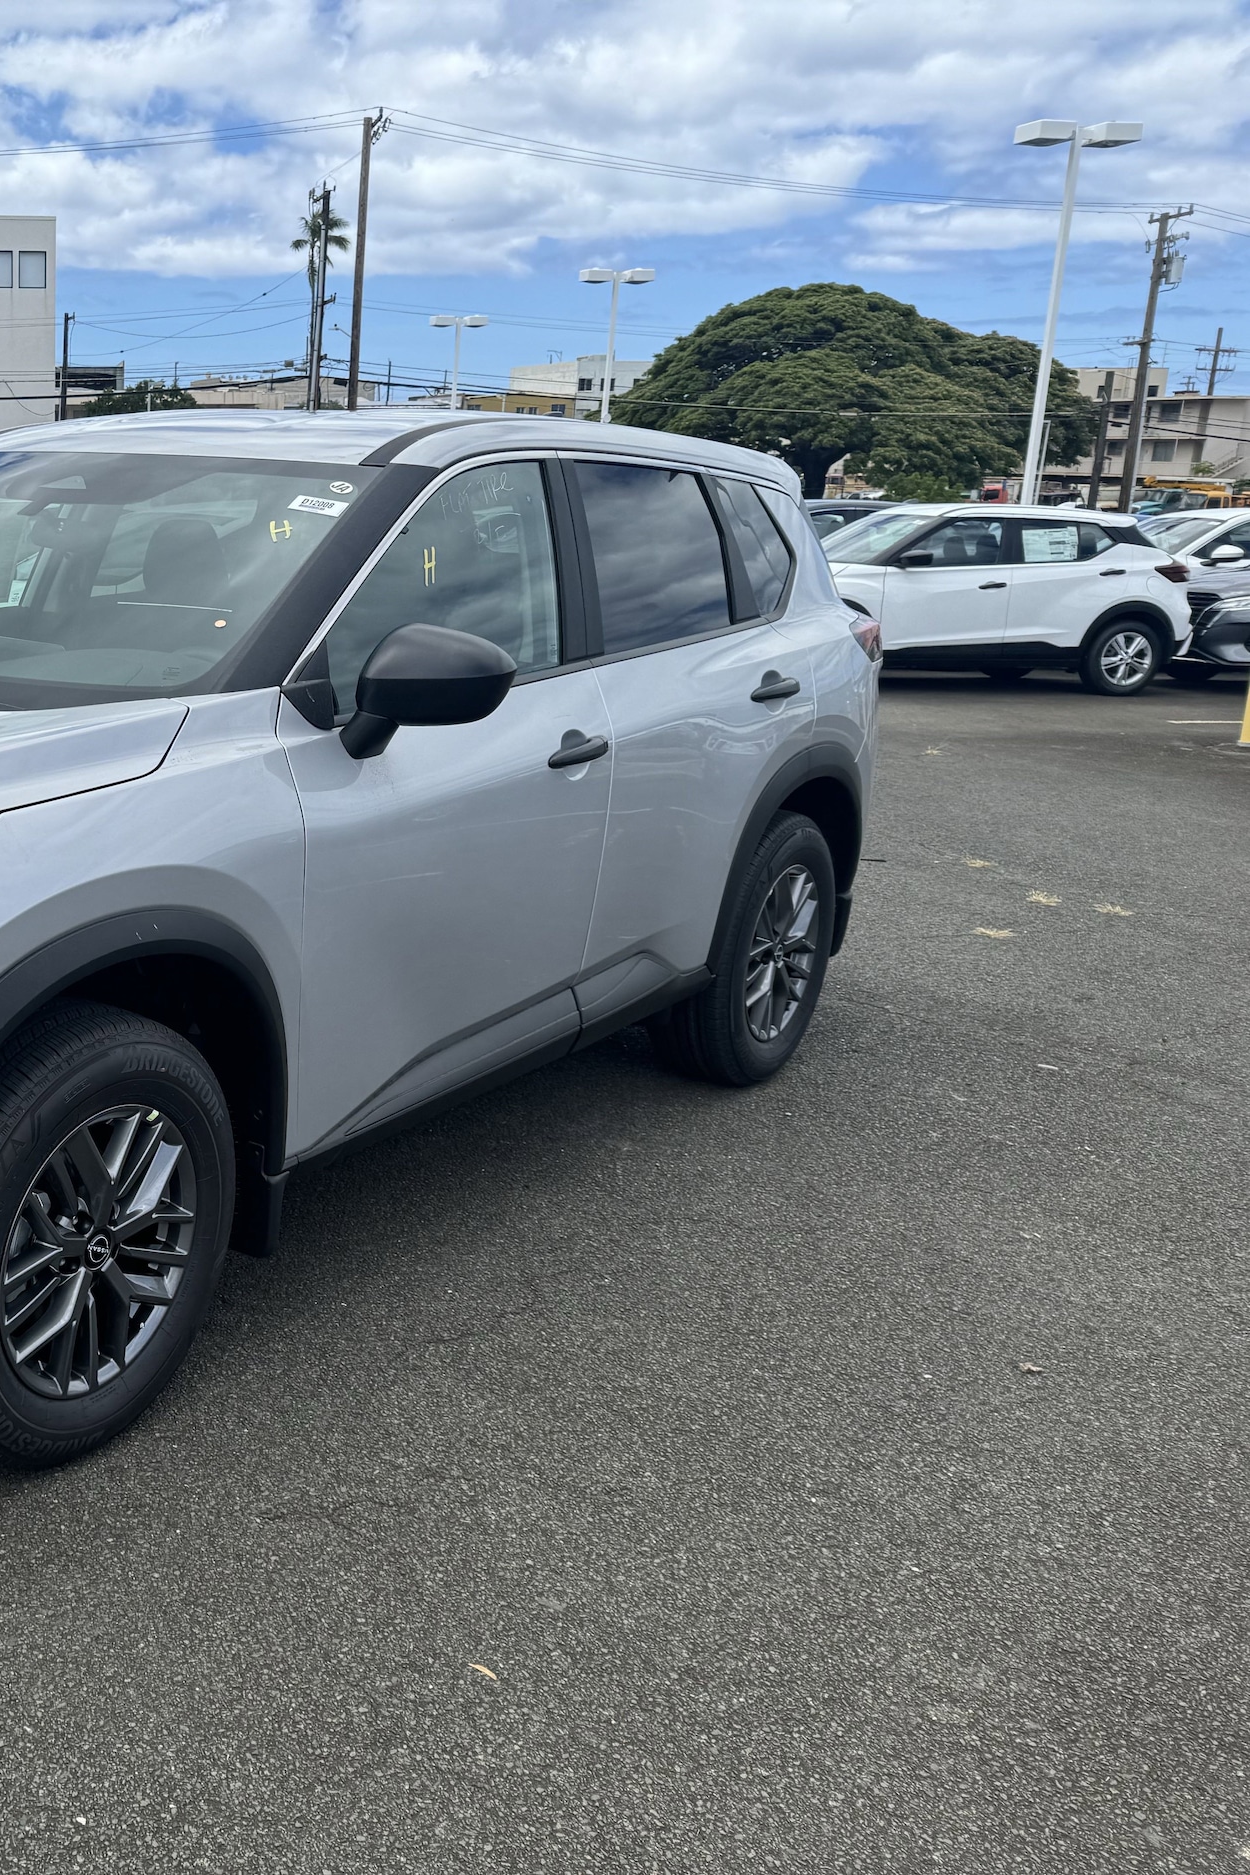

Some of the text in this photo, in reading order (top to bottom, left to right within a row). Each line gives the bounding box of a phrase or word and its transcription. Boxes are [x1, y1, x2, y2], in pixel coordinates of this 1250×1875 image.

[270, 520, 293, 542] H
[423, 546, 436, 587] H
[121, 1045, 225, 1128] BRIDGESTONE
